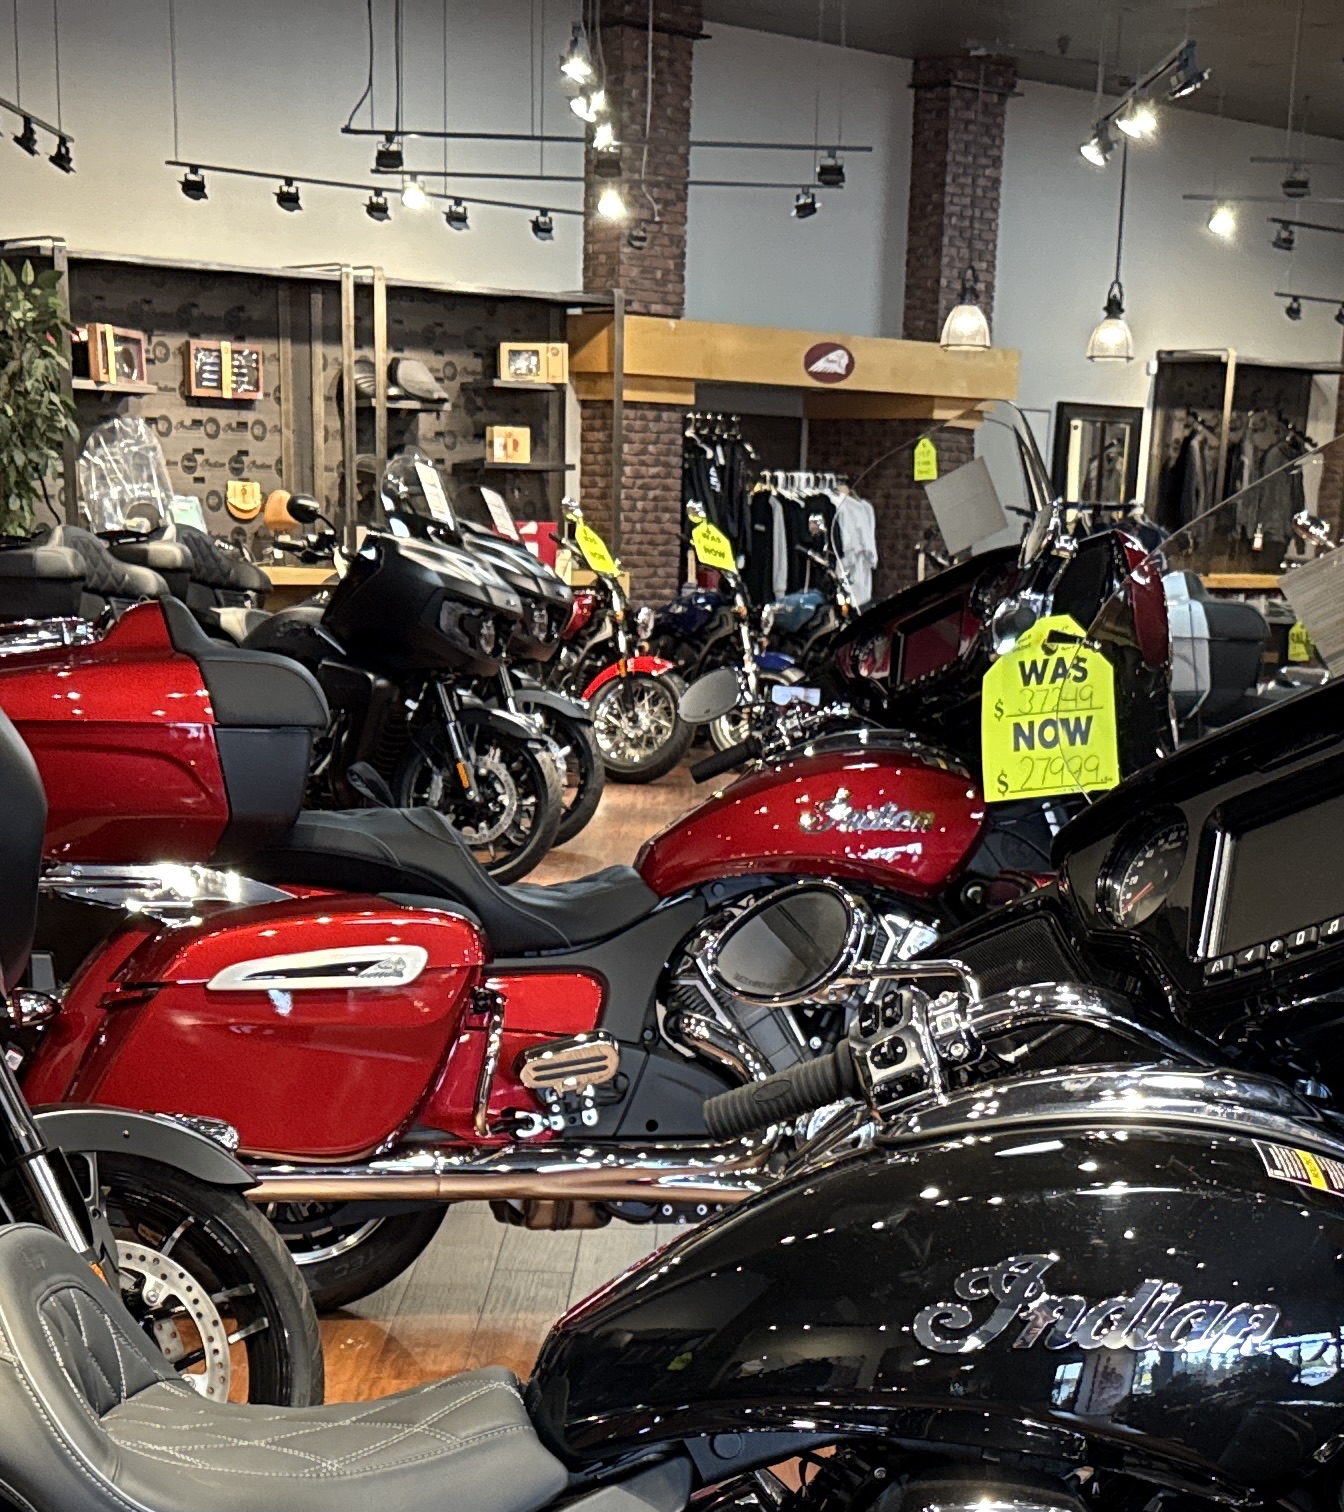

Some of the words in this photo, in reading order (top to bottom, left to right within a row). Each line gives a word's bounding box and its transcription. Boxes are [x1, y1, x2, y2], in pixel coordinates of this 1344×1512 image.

[1018, 656, 1089, 688] WAS
[994, 699, 1004, 721] $
[1018, 685, 1095, 714] 37249
[1012, 715, 1094, 753] NOW
[997, 770, 1009, 796] $
[798, 787, 936, 835] Indian
[913, 1253, 1283, 1355] Indian
